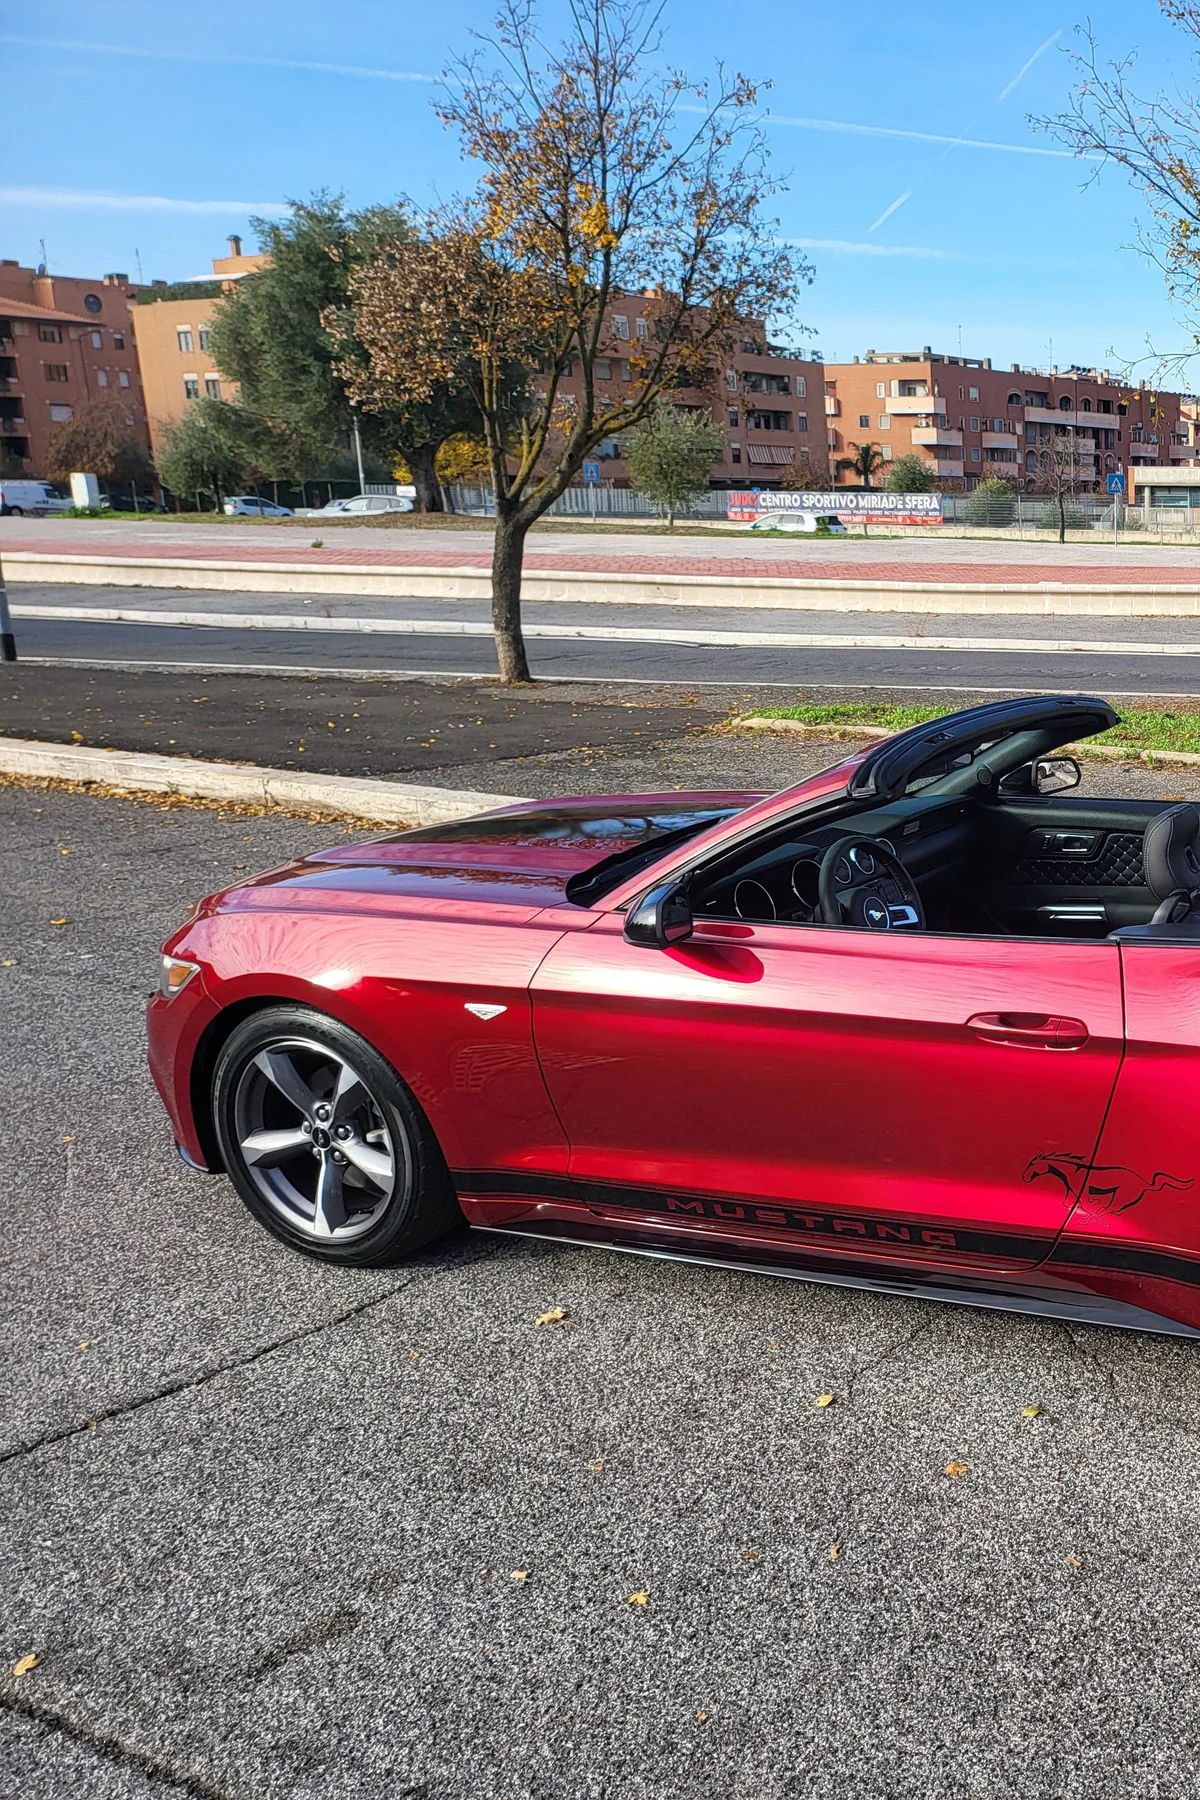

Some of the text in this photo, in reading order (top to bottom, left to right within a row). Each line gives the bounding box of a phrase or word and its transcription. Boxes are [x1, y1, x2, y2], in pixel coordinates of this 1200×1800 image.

[729, 492, 940, 510] JUDO CENTRO SPORTIVO MIRIADE SFERA
[665, 1198, 957, 1247] MUSTANG
